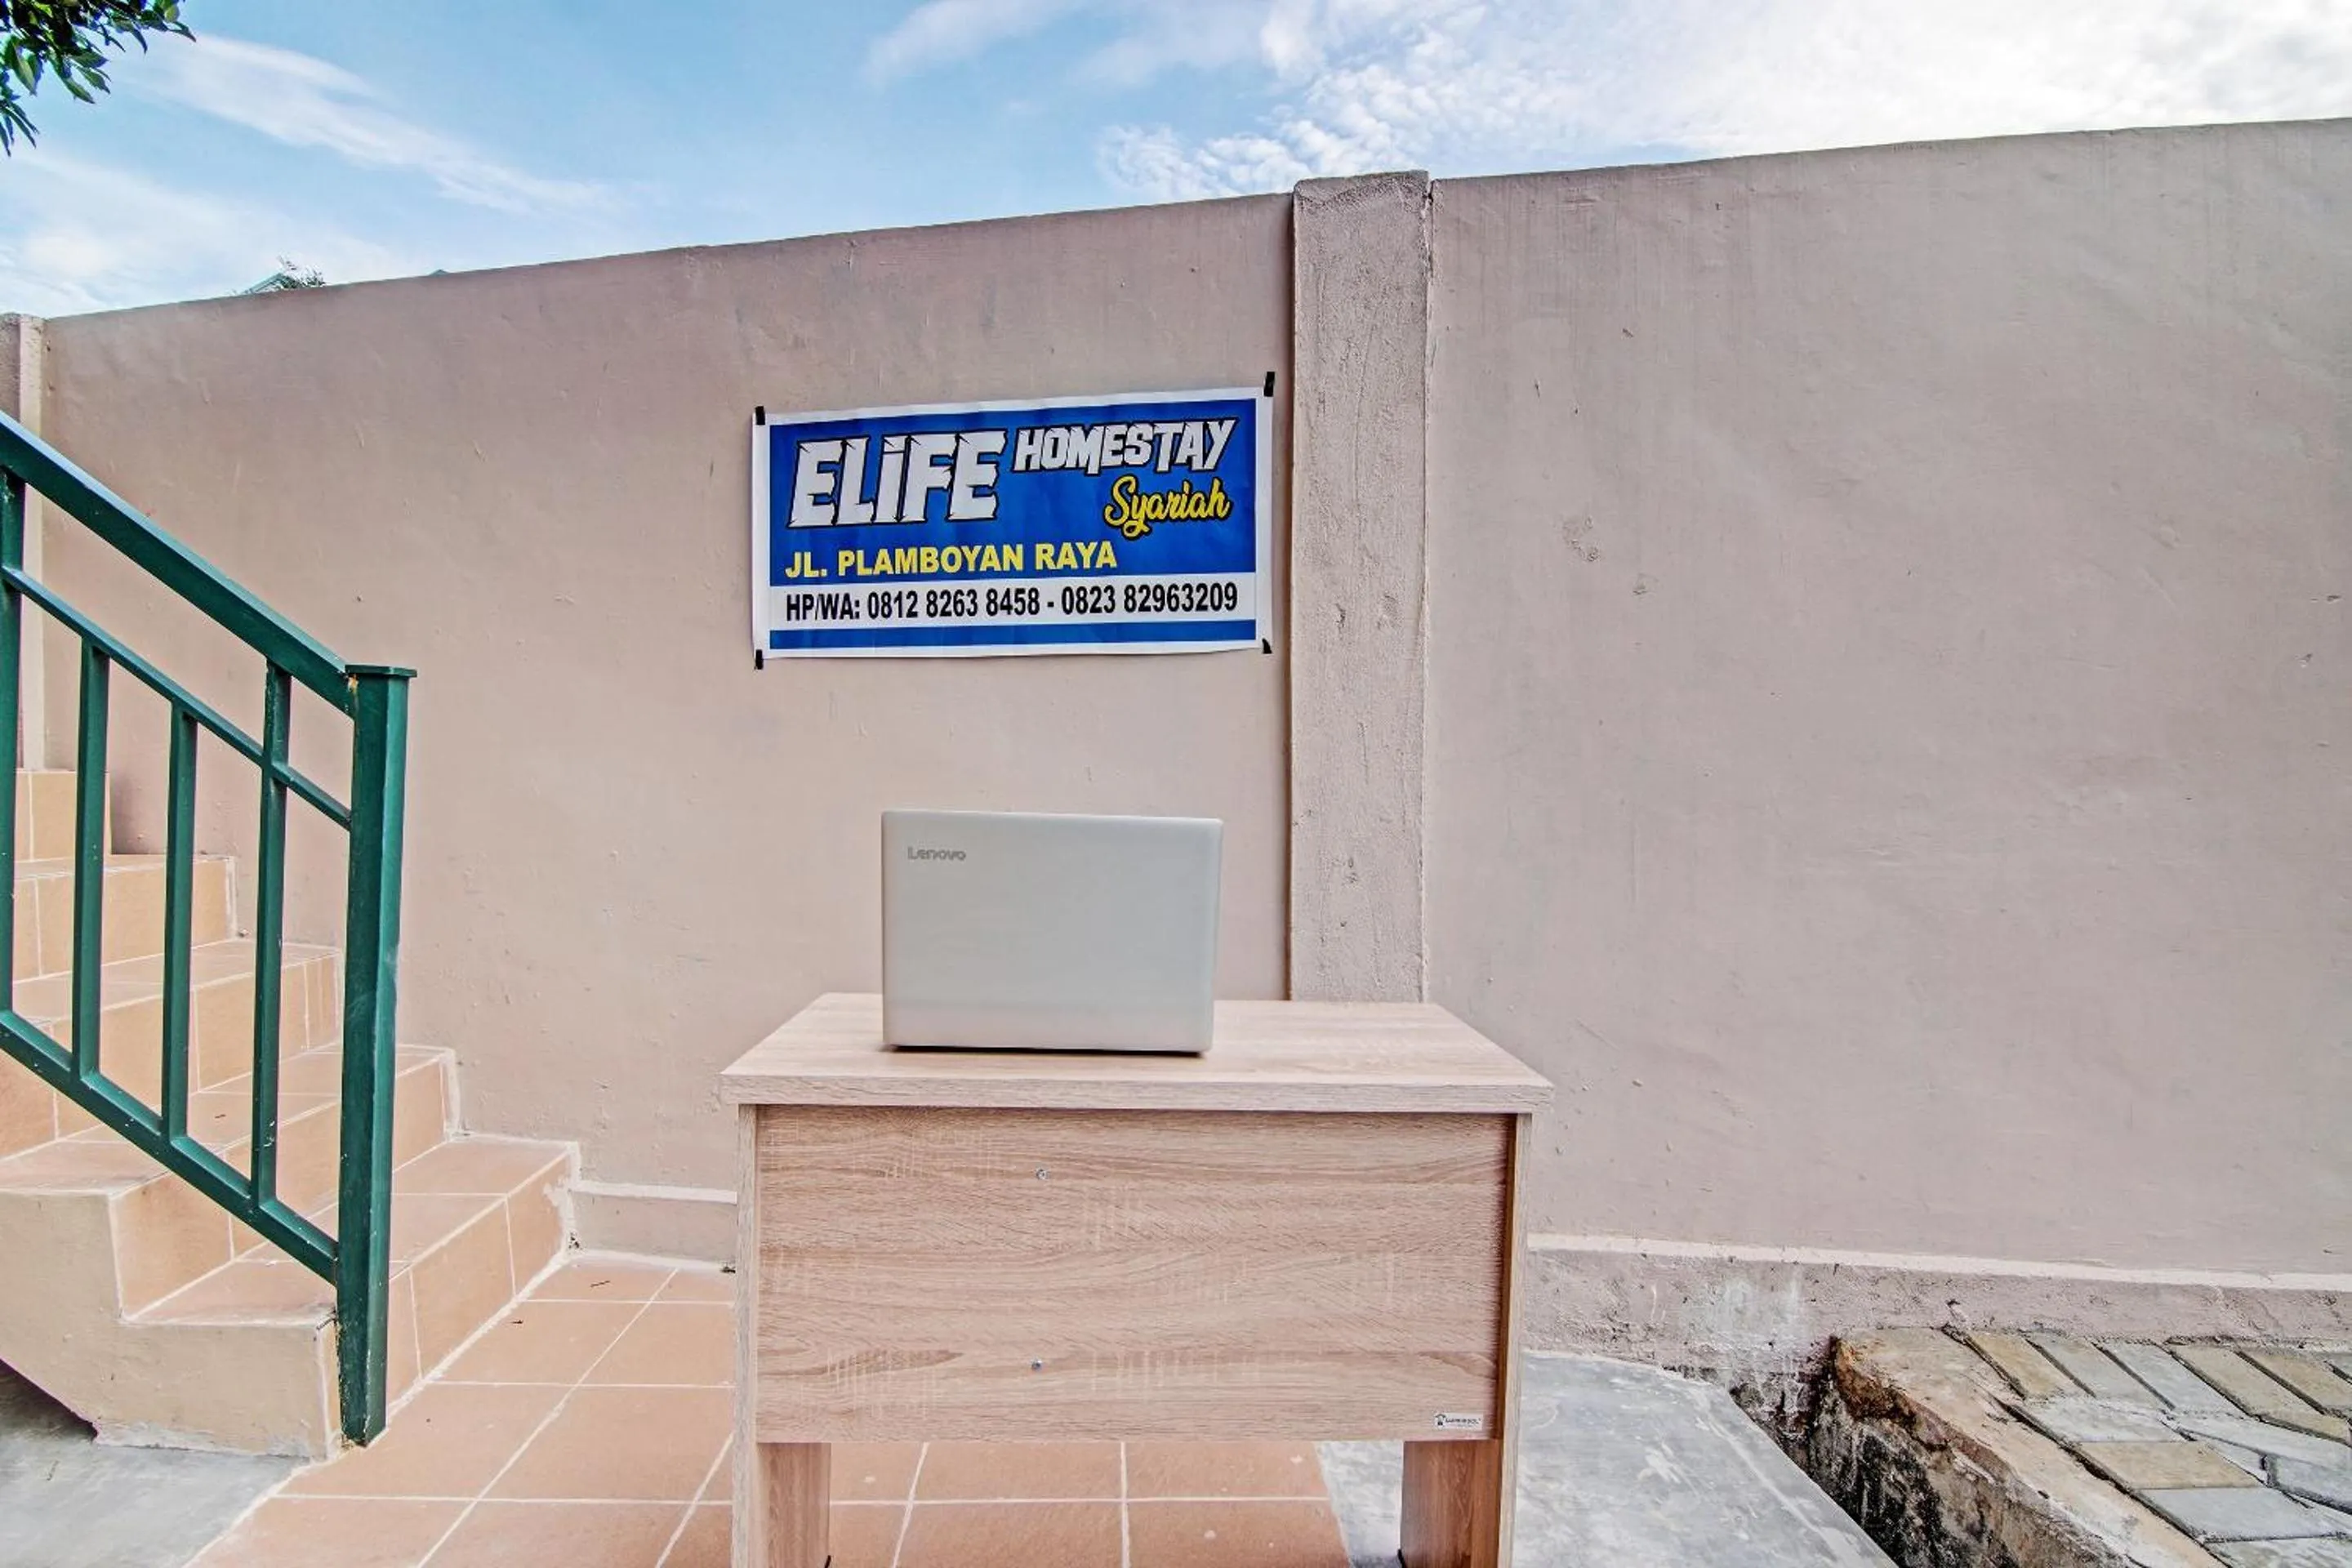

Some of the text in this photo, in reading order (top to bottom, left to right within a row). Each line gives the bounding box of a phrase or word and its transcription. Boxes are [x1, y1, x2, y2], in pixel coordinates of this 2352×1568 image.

[1013, 418, 1238, 476] HOMESTAY
[1103, 475, 1232, 540] Syariah
[786, 541, 1117, 578] JL. PLAMBOYAN RAYA
[786, 593, 860, 621] HP/WA:
[867, 590, 919, 618] 0812
[926, 589, 978, 617] 8263
[986, 586, 1039, 615] 8458
[1062, 585, 1116, 614] 0823
[1123, 582, 1238, 612] 82963209
[907, 847, 966, 861] Lenovo
